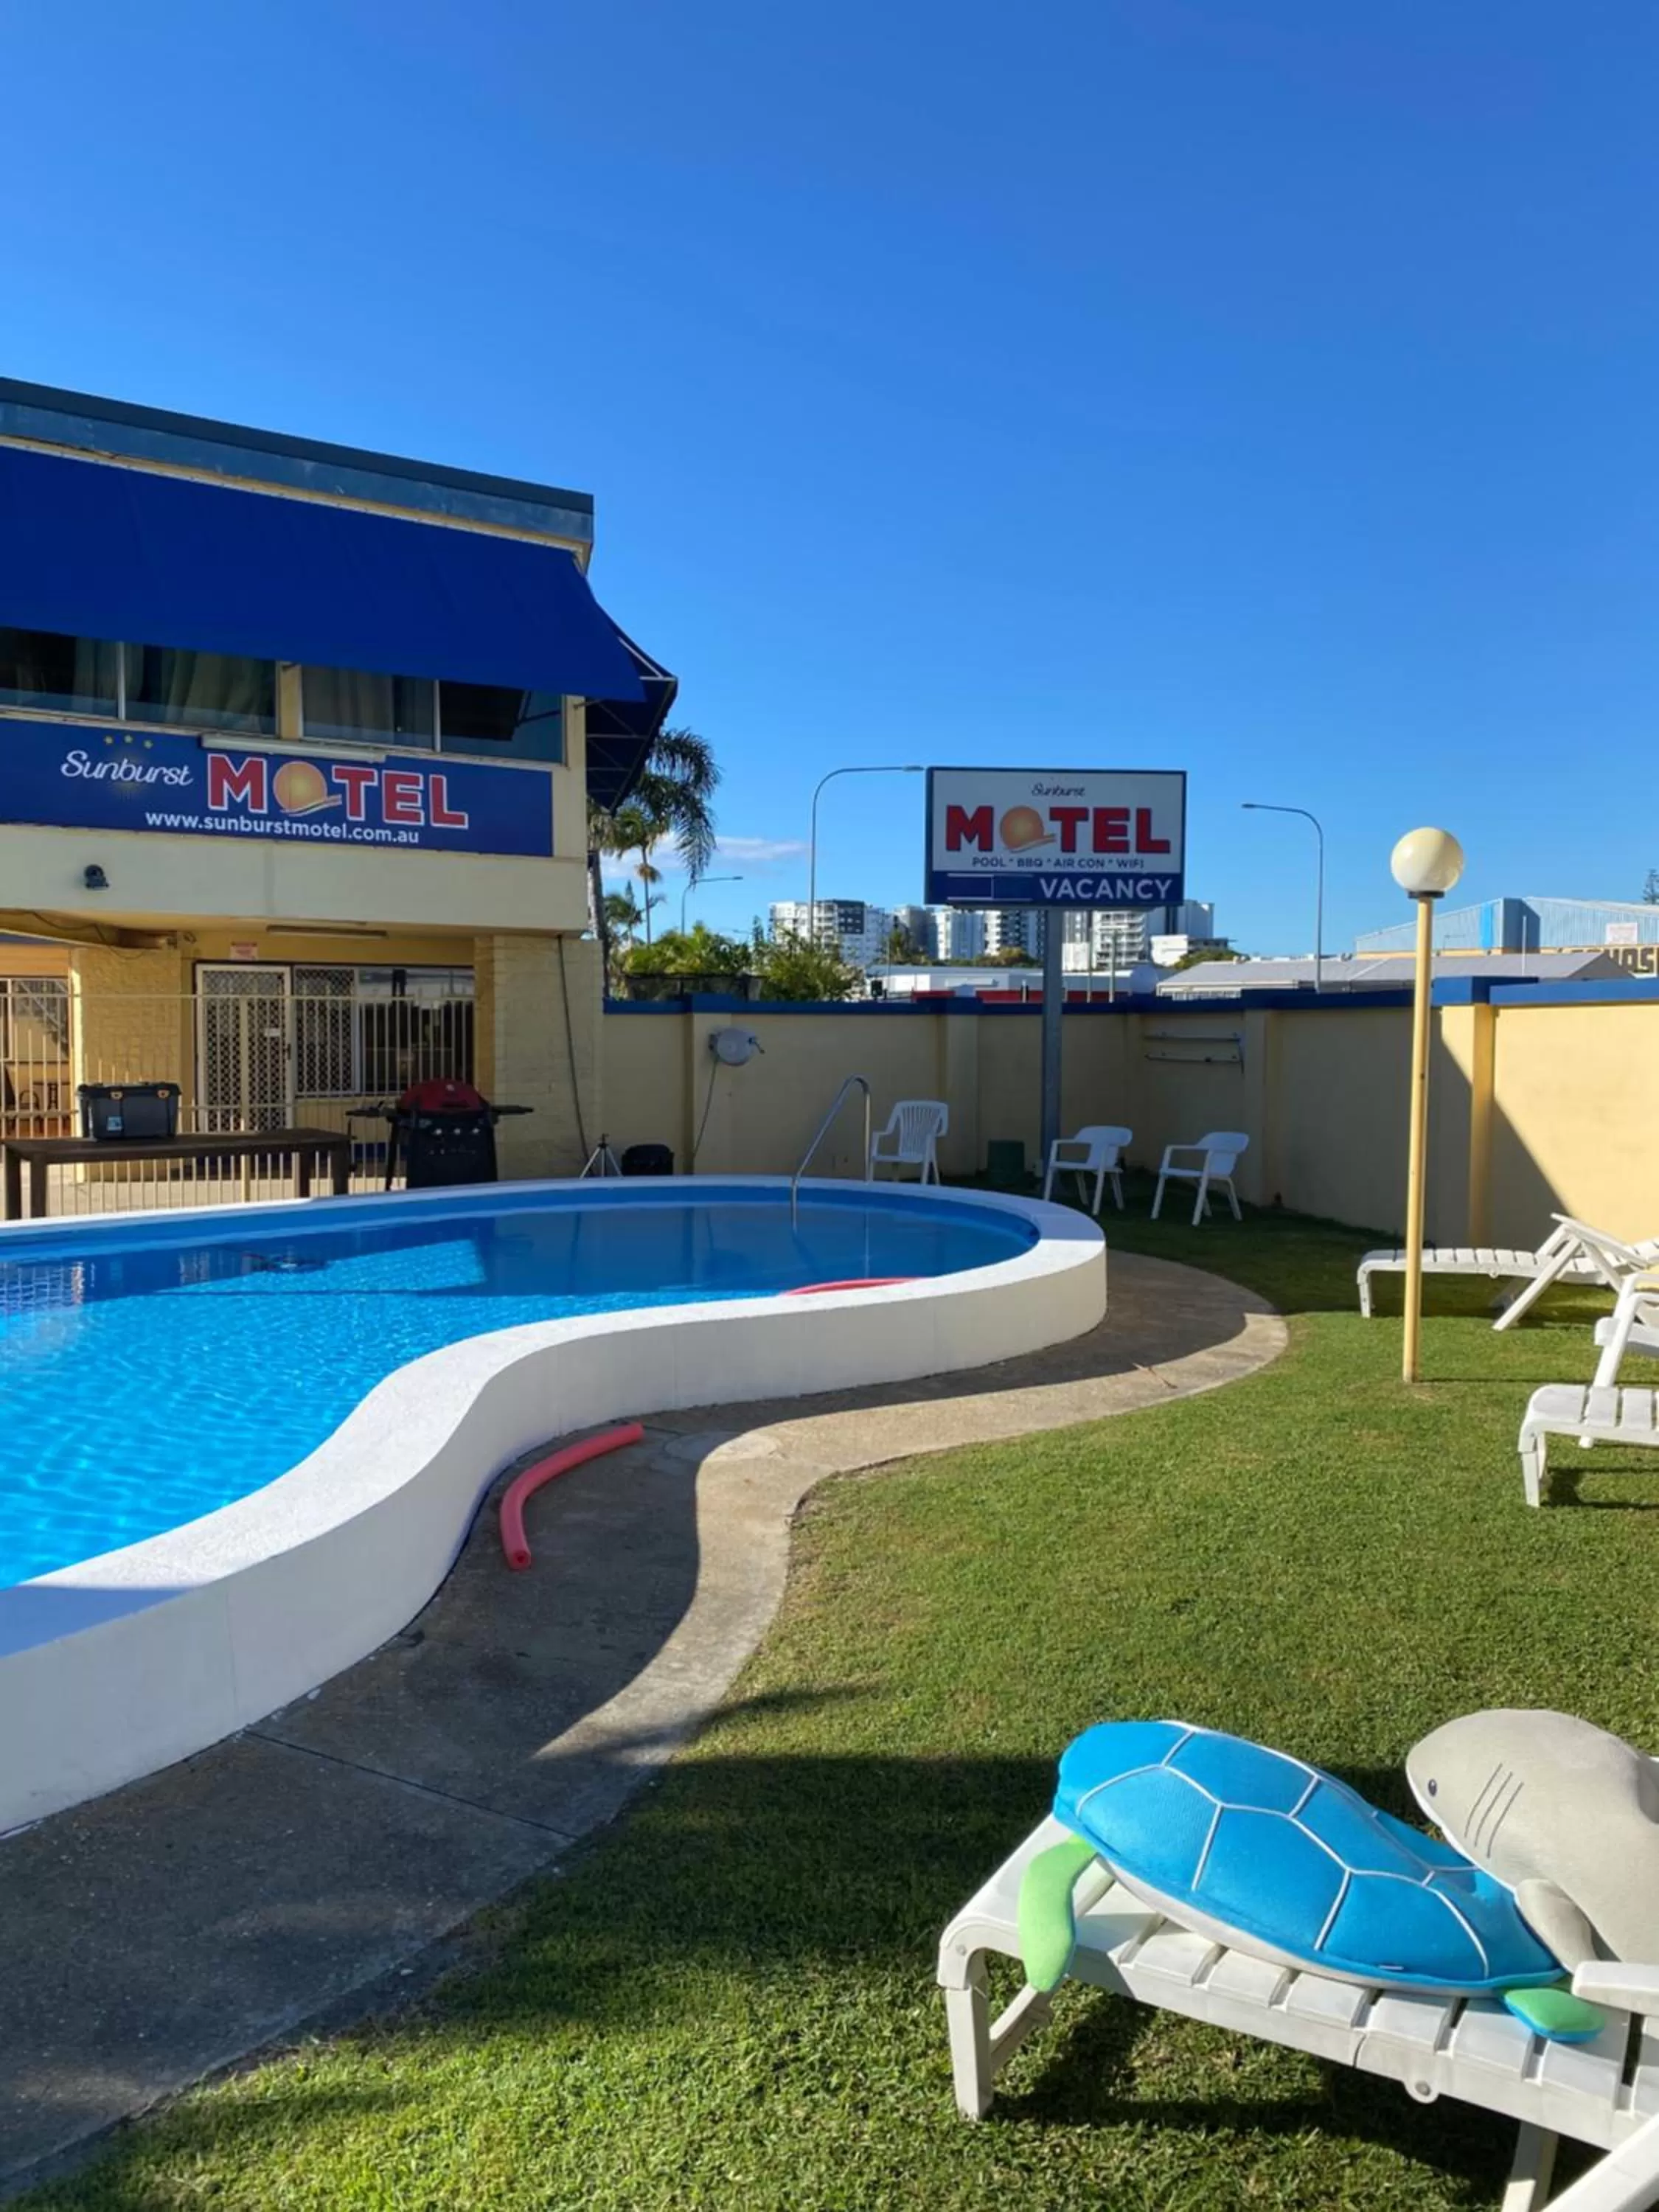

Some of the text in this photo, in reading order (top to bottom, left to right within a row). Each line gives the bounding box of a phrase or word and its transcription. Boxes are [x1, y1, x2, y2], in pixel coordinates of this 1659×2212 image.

[60, 750, 194, 786] Sunburst
[207, 753, 469, 830] MOTEL
[1032, 781, 1085, 797] Sunburst
[145, 812, 420, 844] www.sunburstmotel.com.au
[945, 804, 1171, 854] MOTEL
[972, 856, 1144, 869] POOL BBQ AIR CON WIFI
[1039, 877, 1173, 900] VACANCY
